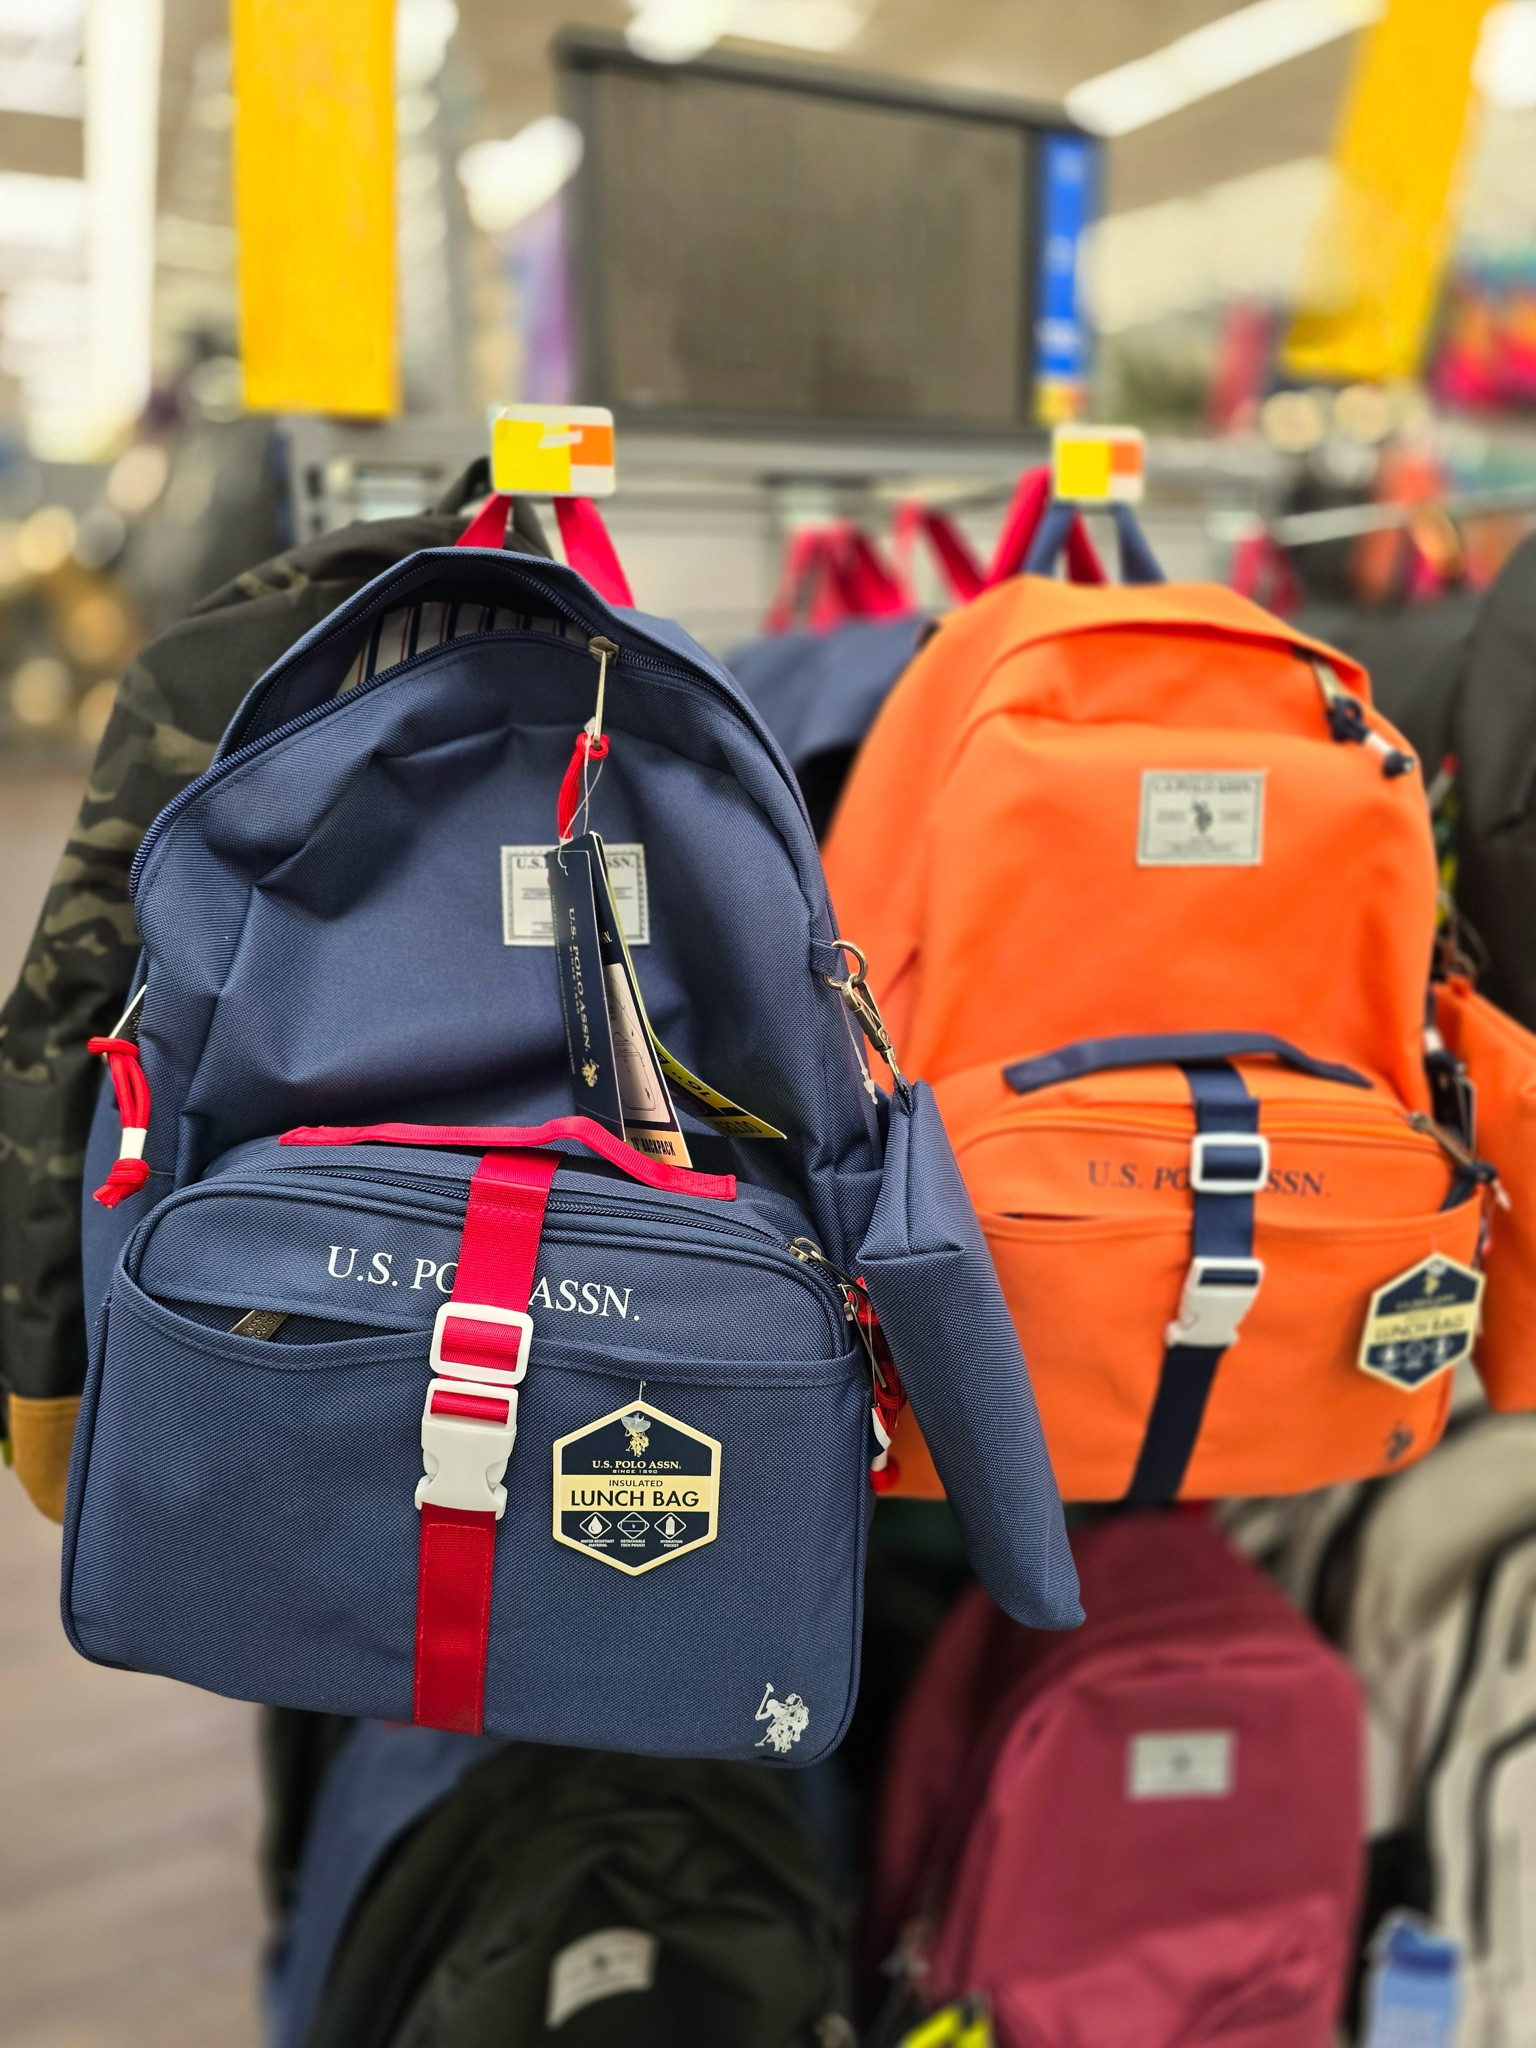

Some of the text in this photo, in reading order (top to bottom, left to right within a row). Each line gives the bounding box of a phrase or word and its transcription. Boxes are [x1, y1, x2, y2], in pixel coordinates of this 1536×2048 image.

[516, 858, 543, 869] U.S.
[568, 907, 591, 1052] U.S. POLO ASSN.
[640, 1138, 677, 1157] BACKPACK
[1088, 1159, 1332, 1199] U.S. PO SSN.
[327, 1245, 640, 1322] U.S. PO ASSN.
[592, 1460, 682, 1470] U.S. POLO ASSN.
[609, 1479, 663, 1487] INSULATED
[571, 1490, 699, 1507] LUNCH BAG
